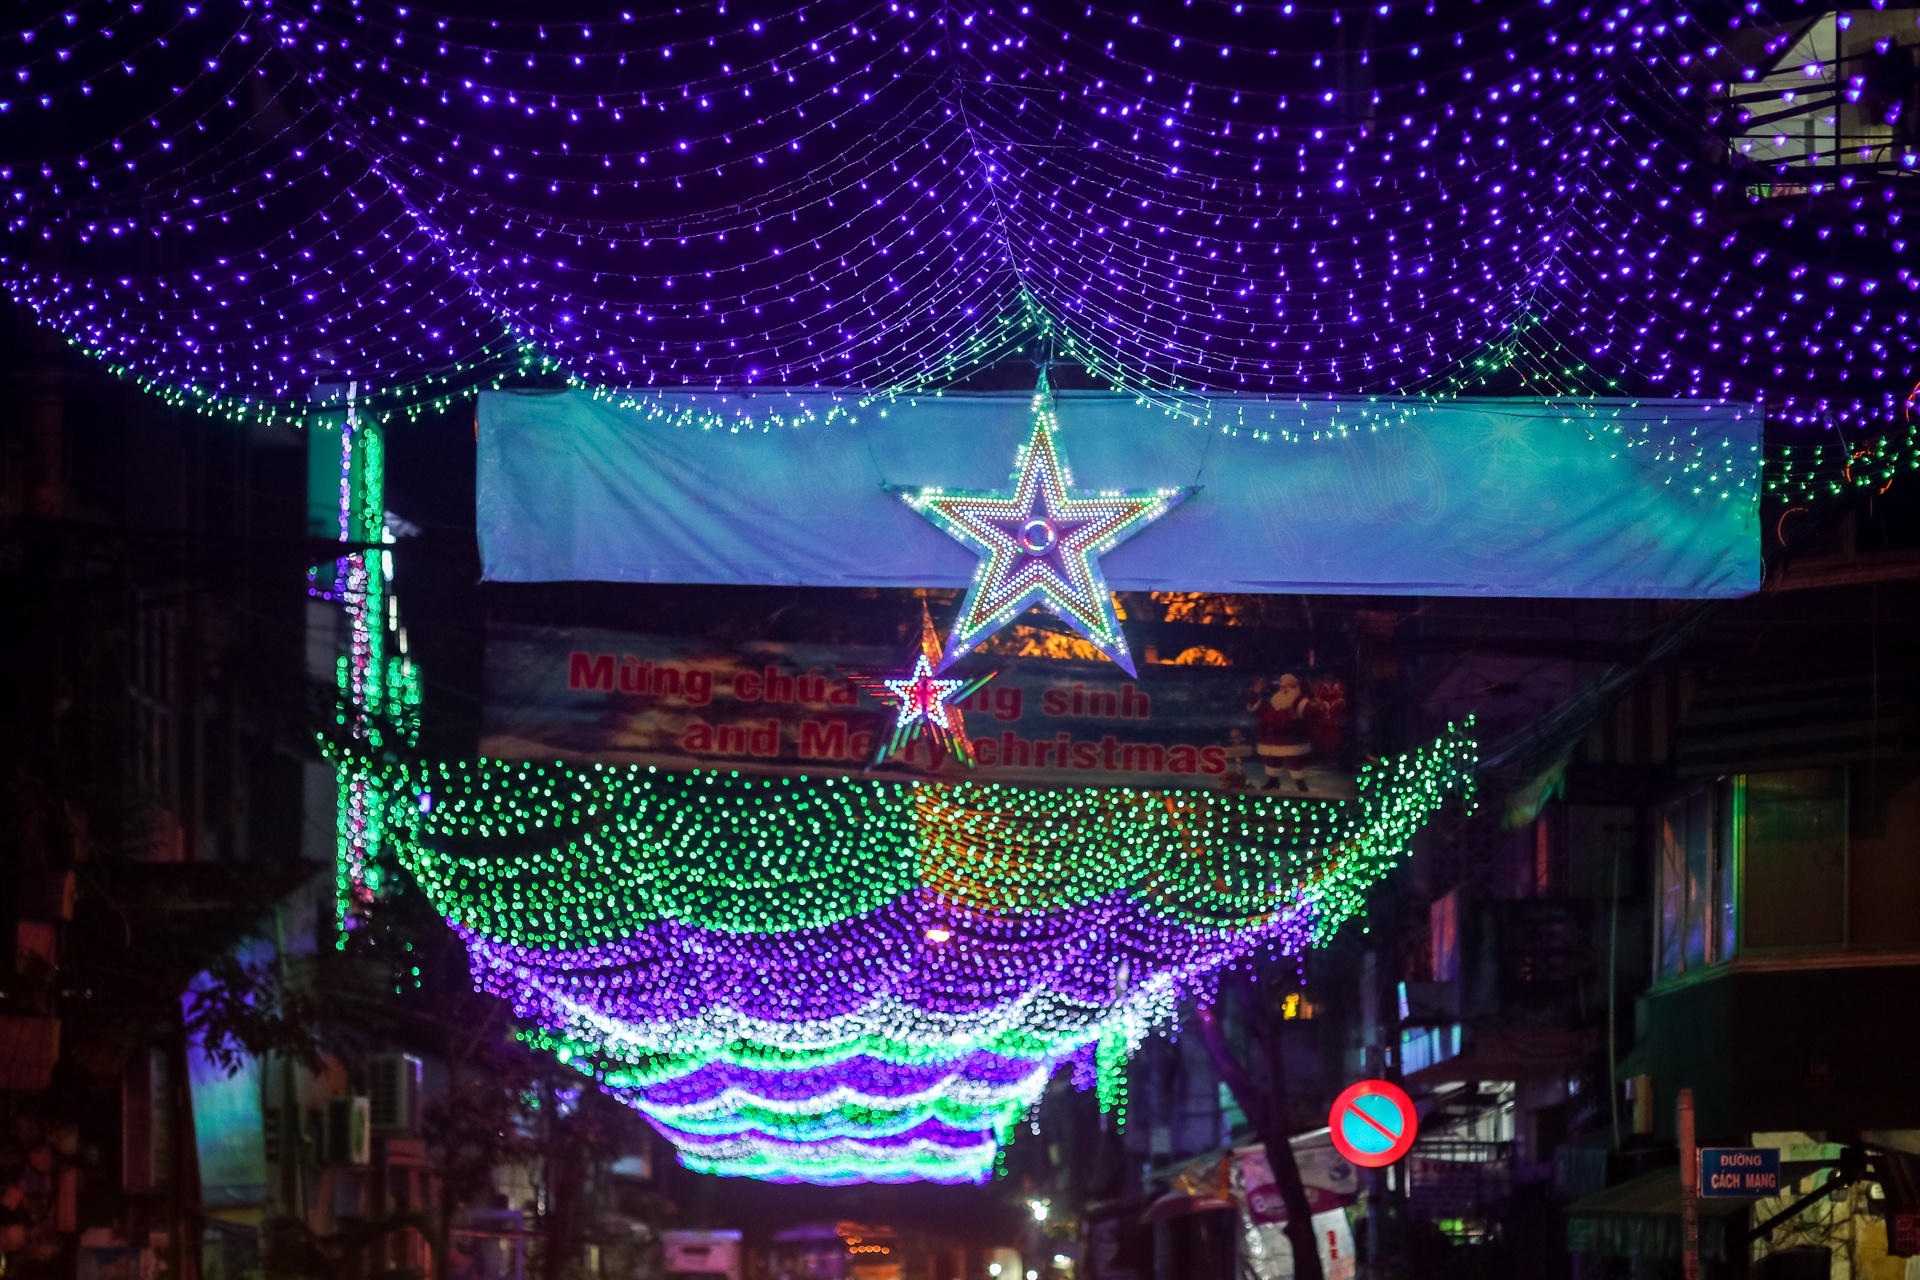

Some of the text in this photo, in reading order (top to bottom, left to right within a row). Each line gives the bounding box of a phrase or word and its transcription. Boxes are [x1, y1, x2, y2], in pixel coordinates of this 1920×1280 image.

[569, 652, 713, 706] Mừng
[733, 664, 860, 706] chúa
[1041, 681, 1151, 719] sinh
[683, 718, 1228, 775] and Mery christmas
[1720, 1153, 1762, 1166] ĐƯỜNG
[1711, 1170, 1776, 1193] CÁCH MẠNG
